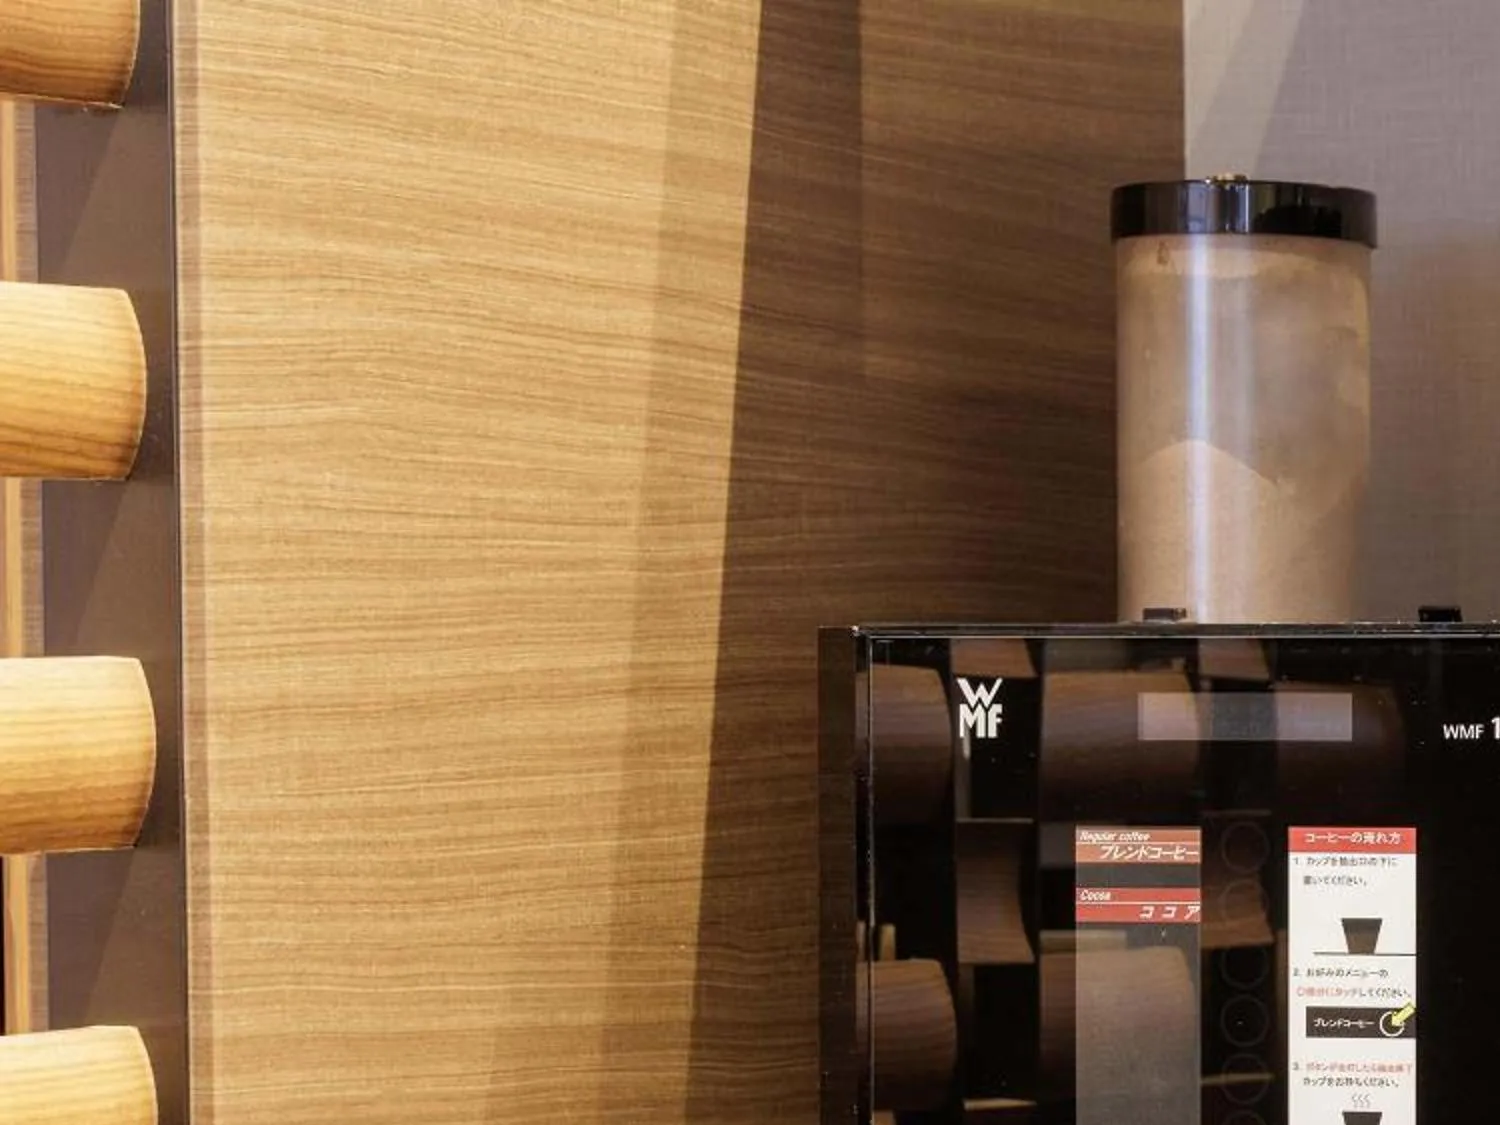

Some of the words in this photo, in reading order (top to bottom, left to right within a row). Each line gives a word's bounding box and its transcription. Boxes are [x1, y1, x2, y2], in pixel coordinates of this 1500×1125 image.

[956, 677, 1003, 739] WMF
[1442, 723, 1485, 740] WMF
[1119, 831, 1151, 842] coffee
[1100, 845, 1199, 861] ブレンドコーヒー
